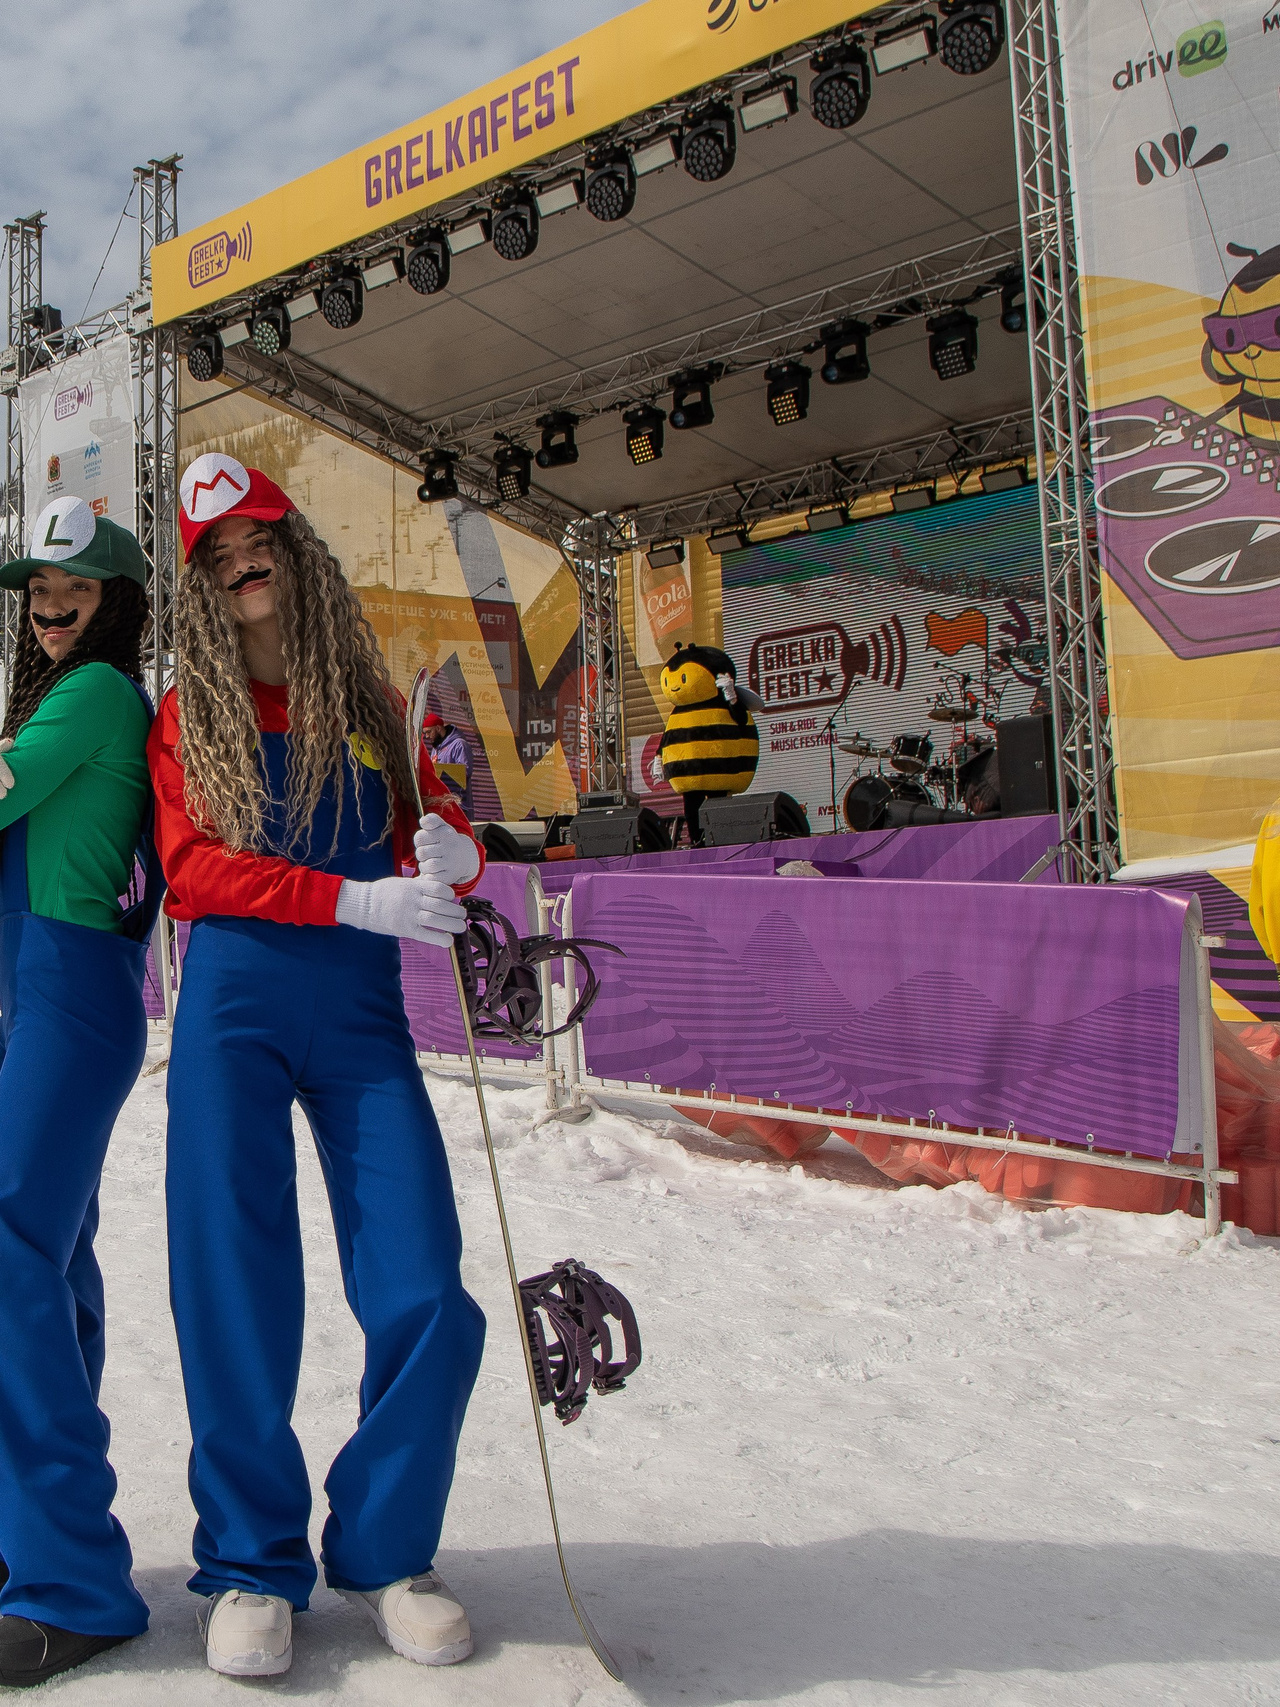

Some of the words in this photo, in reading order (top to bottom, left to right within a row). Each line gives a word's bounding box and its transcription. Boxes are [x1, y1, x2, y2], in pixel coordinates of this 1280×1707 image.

[1112, 29, 1228, 91] drivee
[364, 55, 580, 209] GRELKAFEST
[194, 238, 224, 265] GRELKA
[194, 260, 215, 281] FEST
[58, 390, 76, 406] GRELKA
[58, 403, 71, 417] FEST
[191, 468, 243, 515] M
[89, 496, 108, 517] S!
[44, 514, 73, 546] L
[647, 583, 688, 615] Cola
[430, 608, 458, 621] УЖЕ
[462, 612, 475, 623] 10
[479, 613, 506, 625] ЛЕТ!
[762, 635, 837, 672] GRELKA
[764, 669, 813, 701] FEST
[770, 720, 788, 734] SUN
[788, 719, 797, 733] &
[797, 717, 818, 731] RIDE
[770, 737, 799, 752] MUSIC
[800, 732, 841, 749] FESTIVAL
